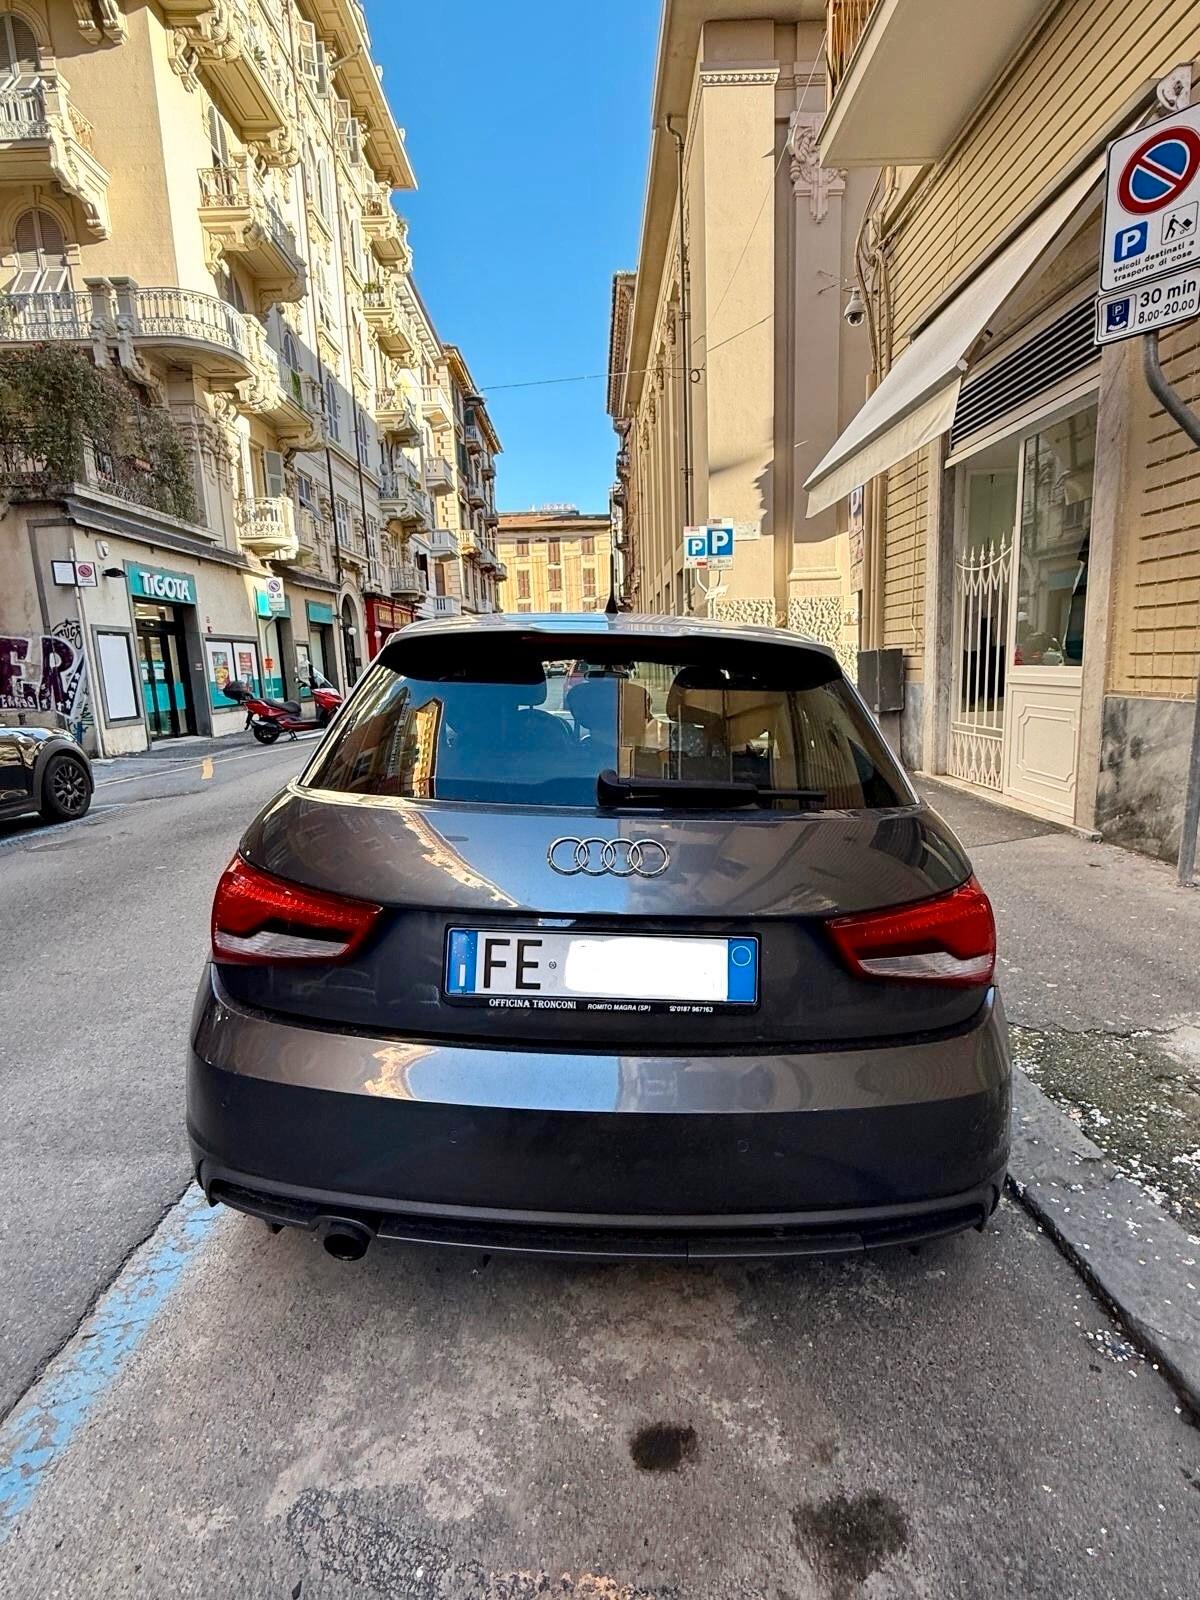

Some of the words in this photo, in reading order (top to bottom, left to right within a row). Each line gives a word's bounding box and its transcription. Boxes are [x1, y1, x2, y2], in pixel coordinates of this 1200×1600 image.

[1114, 258, 1141, 273] veicoli
[1144, 242, 1185, 263] destinati
[1121, 229, 1142, 258] P
[1114, 263, 1155, 282] trasporto
[1158, 257, 1168, 267] di
[1171, 250, 1193, 262] cose
[1140, 288, 1162, 308] 30
[1167, 279, 1196, 299] min
[691, 540, 703, 555] P
[711, 530, 729, 555] P
[483, 938, 543, 990] FE
[489, 998, 531, 1008] OFFICINA
[532, 999, 577, 1010] TRONCONI
[638, 1004, 652, 1012] (SP)
